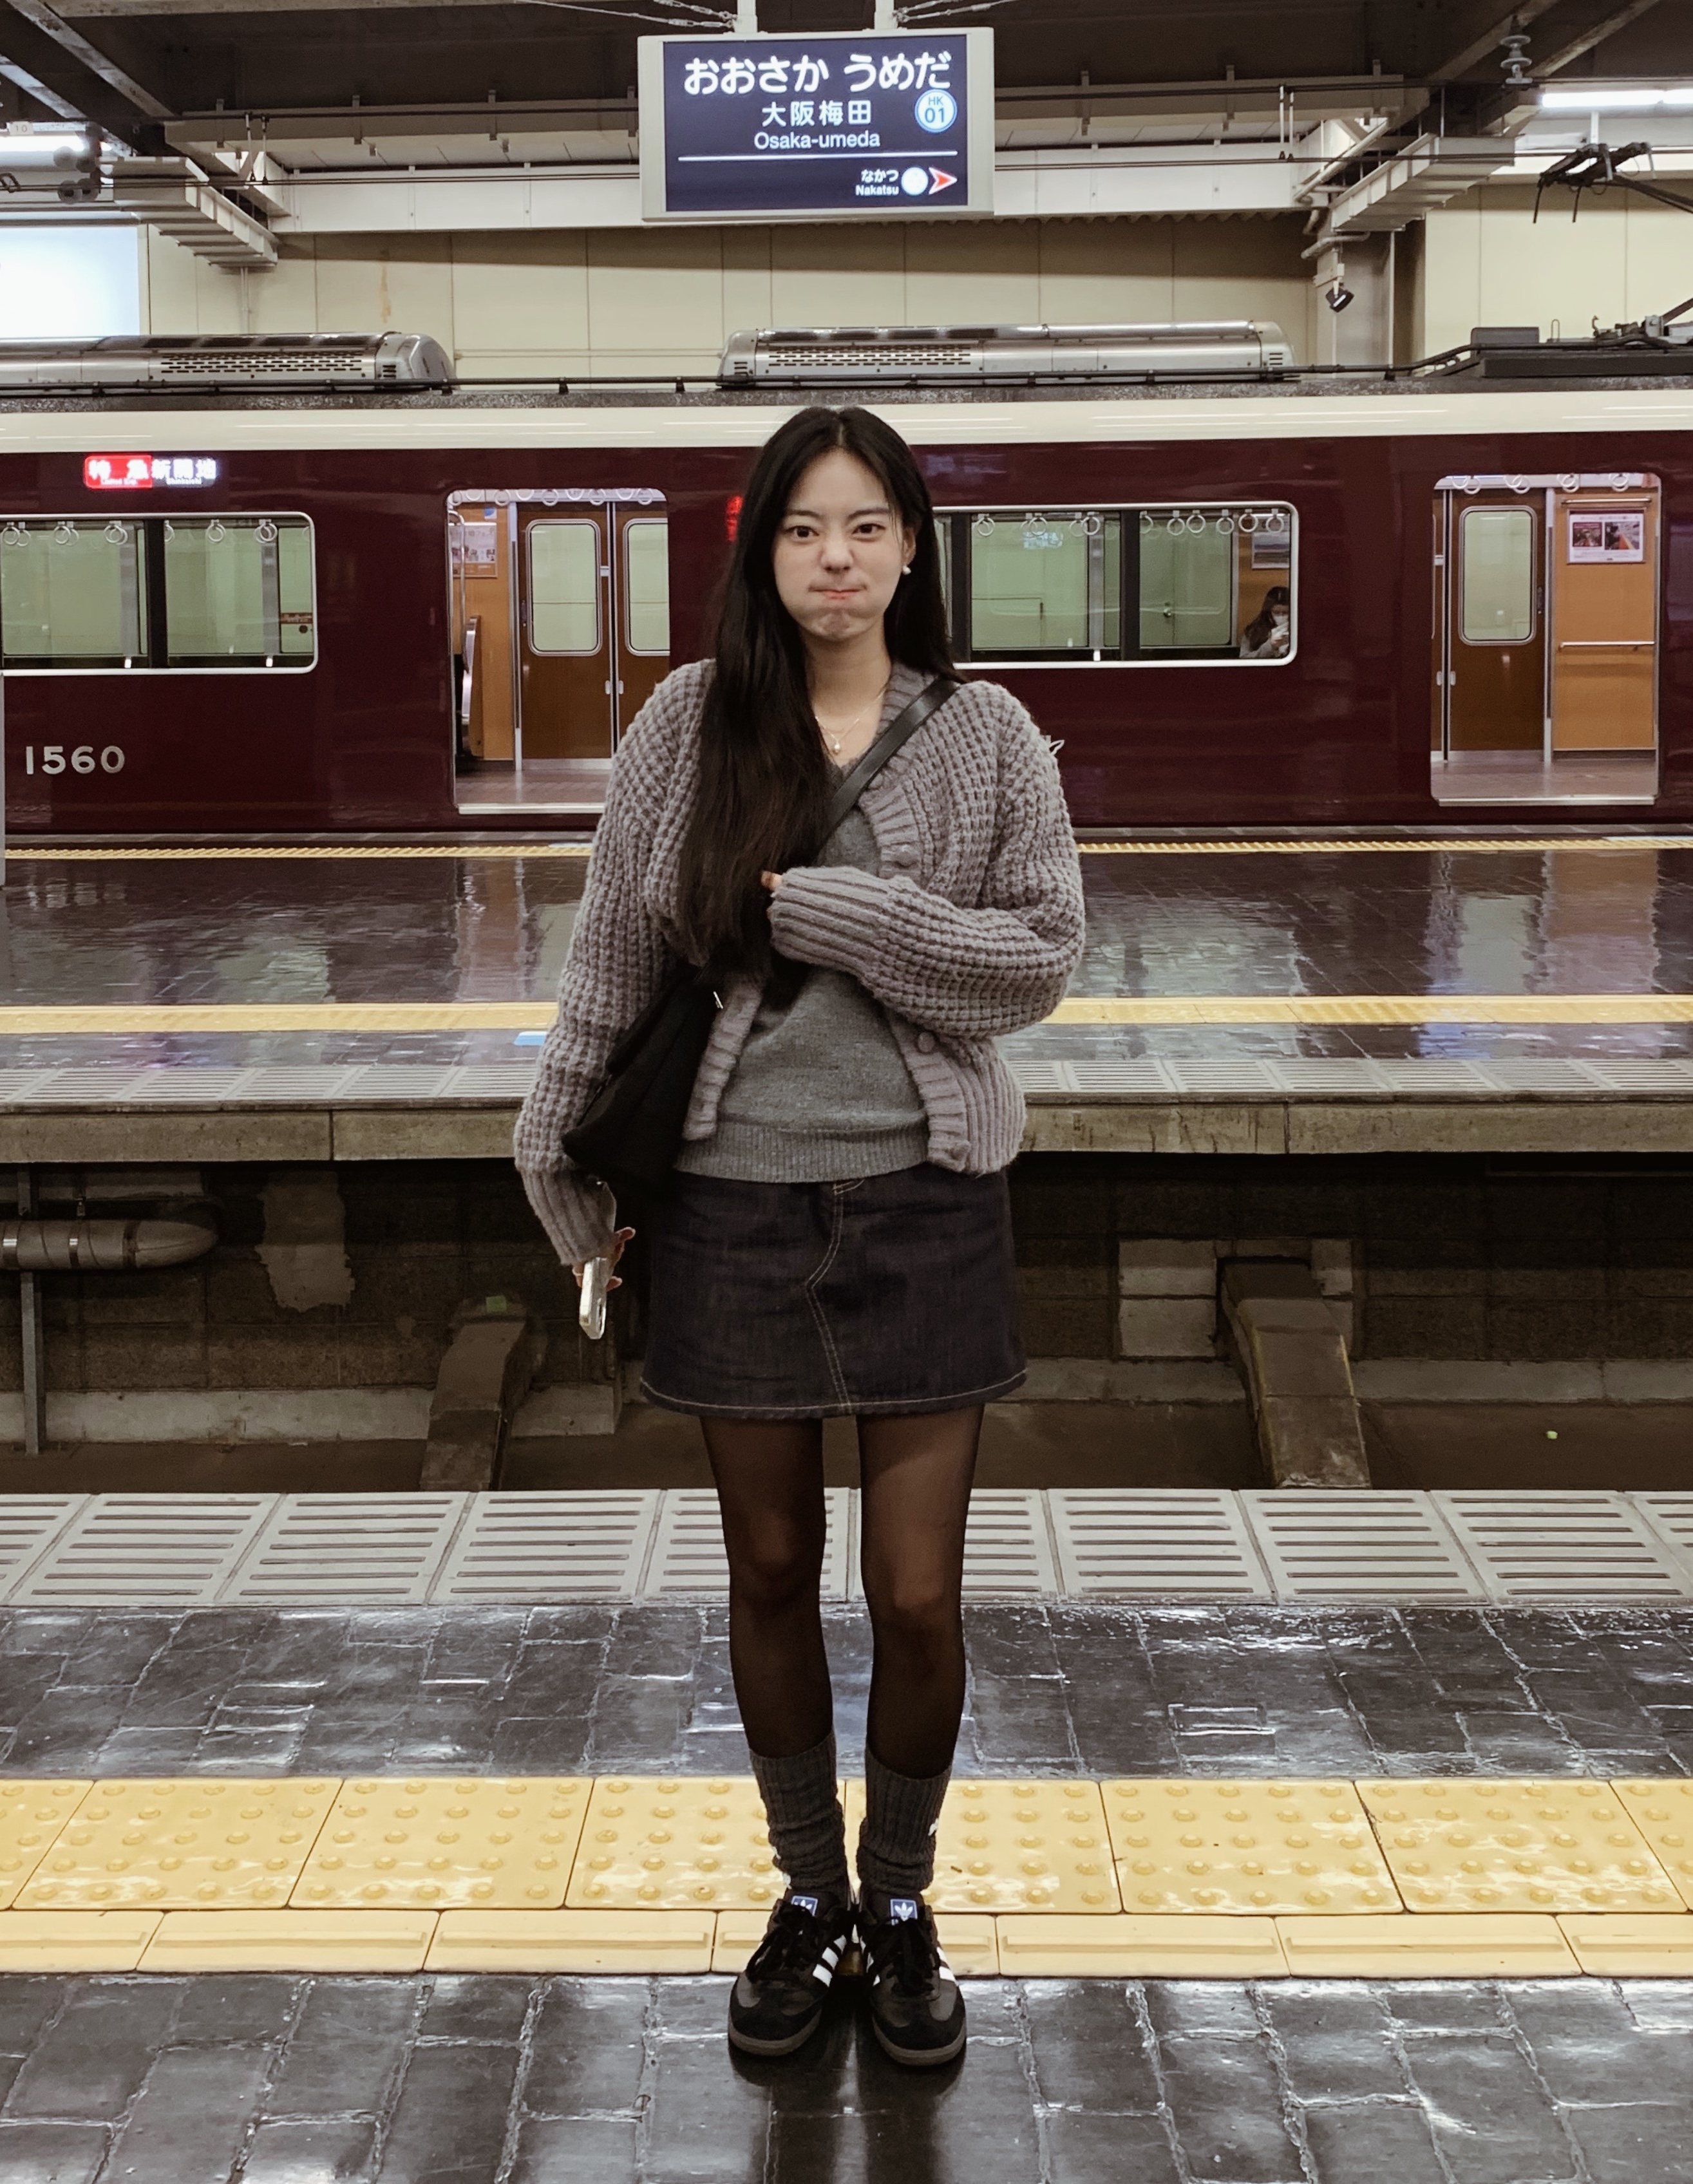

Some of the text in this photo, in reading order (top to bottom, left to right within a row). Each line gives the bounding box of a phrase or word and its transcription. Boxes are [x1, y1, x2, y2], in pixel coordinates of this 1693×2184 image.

[684, 50, 952, 95] おおさか うめだ
[928, 96, 943, 106] HK
[762, 100, 871, 127] 大阪梅田
[925, 108, 944, 123] 01
[754, 129, 880, 150] Osaka-umeda
[861, 169, 899, 183] なかつ
[855, 185, 899, 196] Nakatsu
[26, 746, 125, 775] 1560
